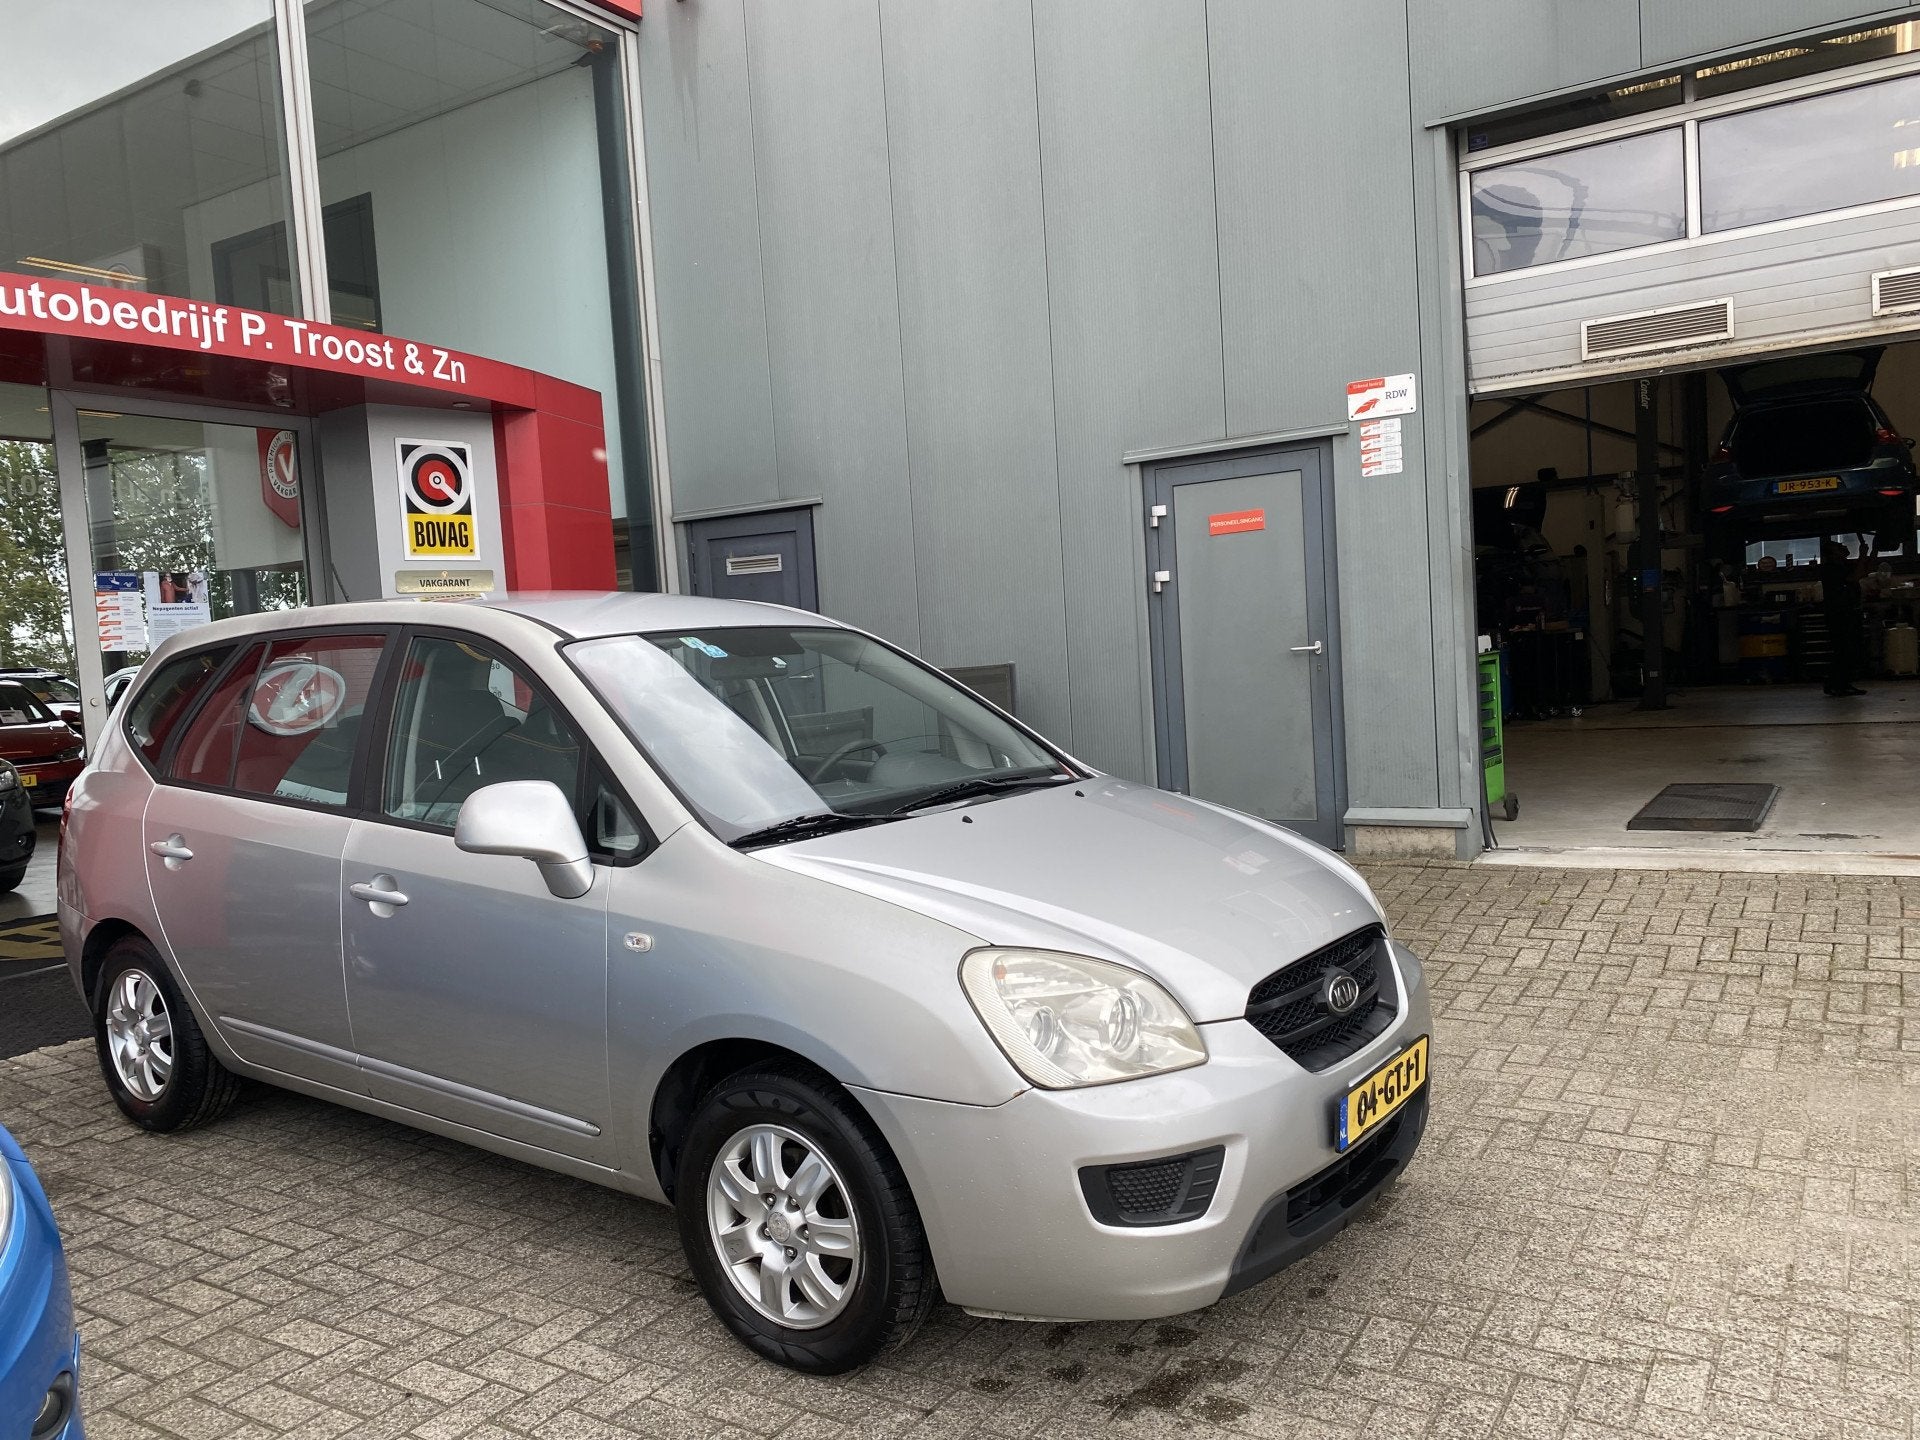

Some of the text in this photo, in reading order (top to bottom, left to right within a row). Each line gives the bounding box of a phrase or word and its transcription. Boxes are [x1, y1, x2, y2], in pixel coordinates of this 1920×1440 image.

[241, 312, 273, 350] P.
[284, 320, 395, 371] Troost
[404, 343, 425, 376] &
[432, 349, 466, 384] Zn
[1385, 389, 1408, 400] RDW
[1640, 379, 1650, 410] Condor
[1782, 479, 1833, 492] JR-953-K
[414, 521, 469, 548] BOVAG
[419, 578, 471, 588] VAKGARANT
[1357, 1048, 1420, 1127] 04-GTJ-1
